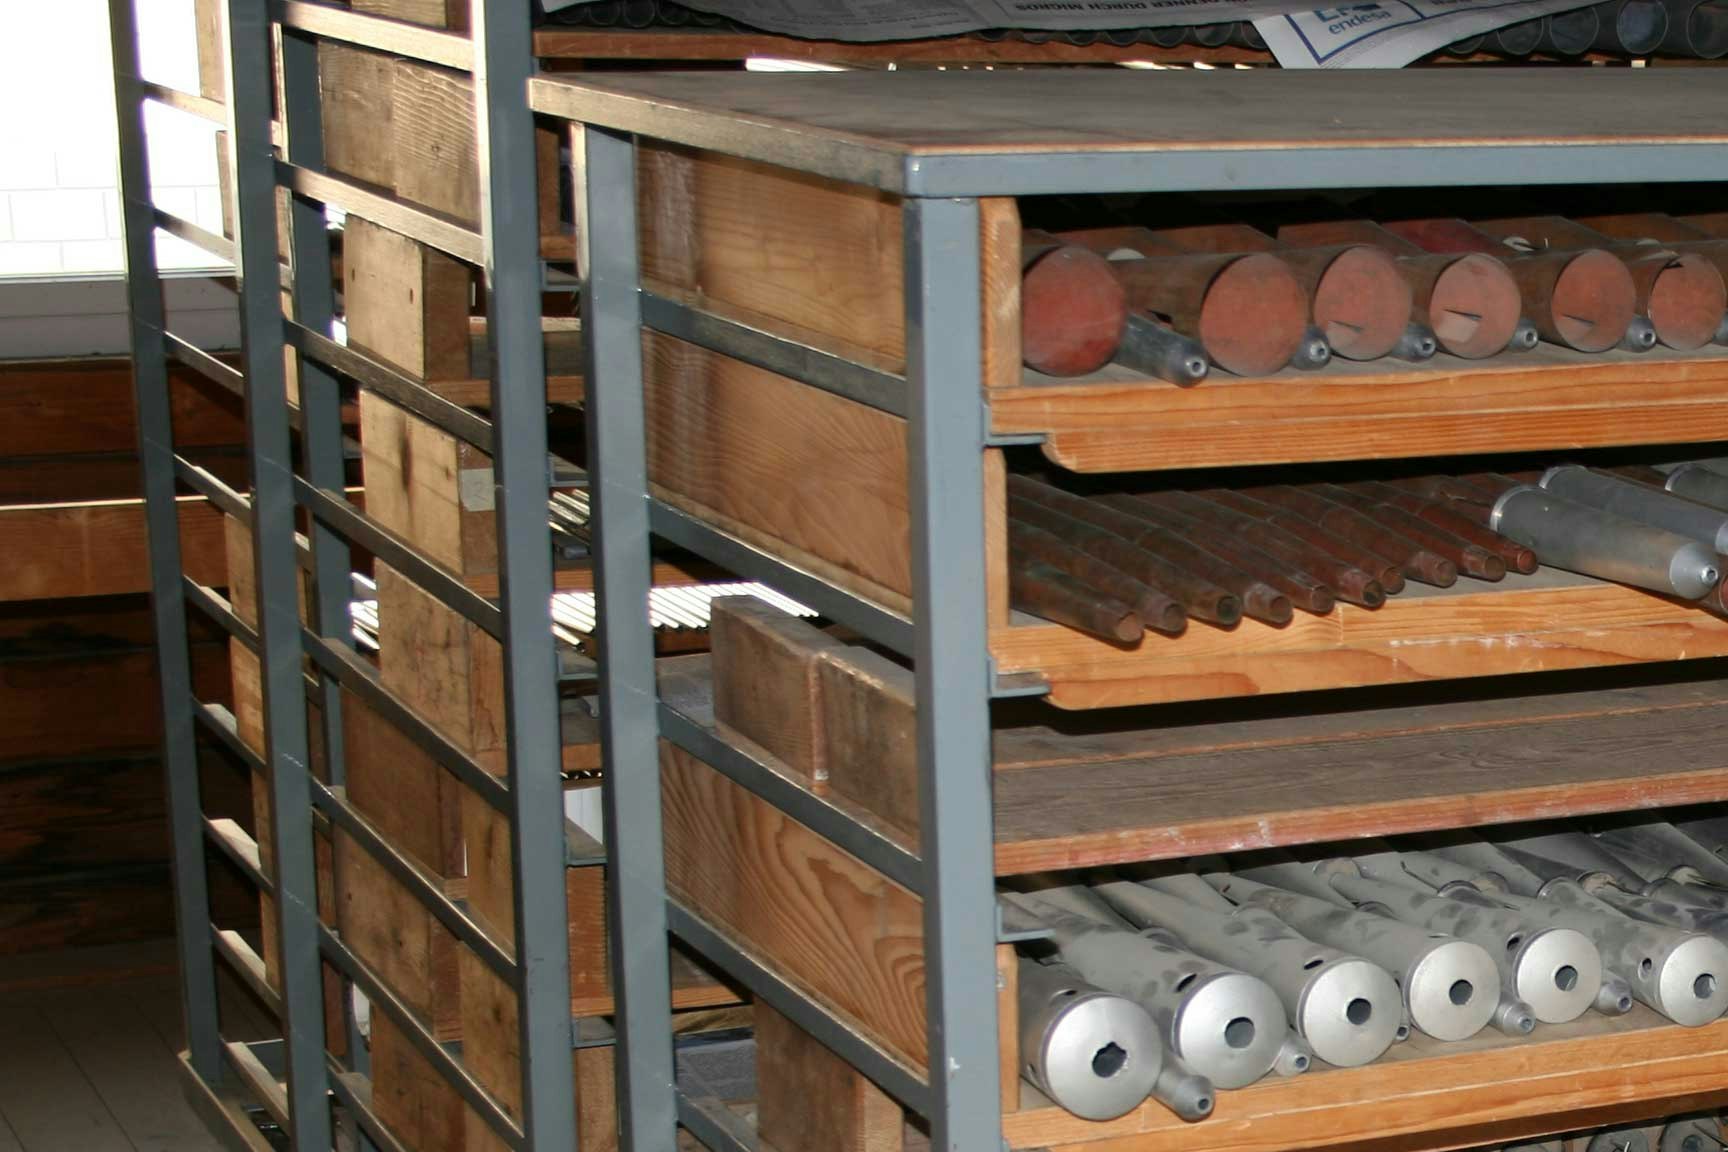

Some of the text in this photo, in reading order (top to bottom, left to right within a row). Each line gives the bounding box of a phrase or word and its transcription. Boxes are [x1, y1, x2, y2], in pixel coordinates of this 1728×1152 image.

[1015, 2, 1085, 11] MIGROS
[1088, 1, 1148, 10] DURCH
[1328, 10, 1392, 36] endesa
